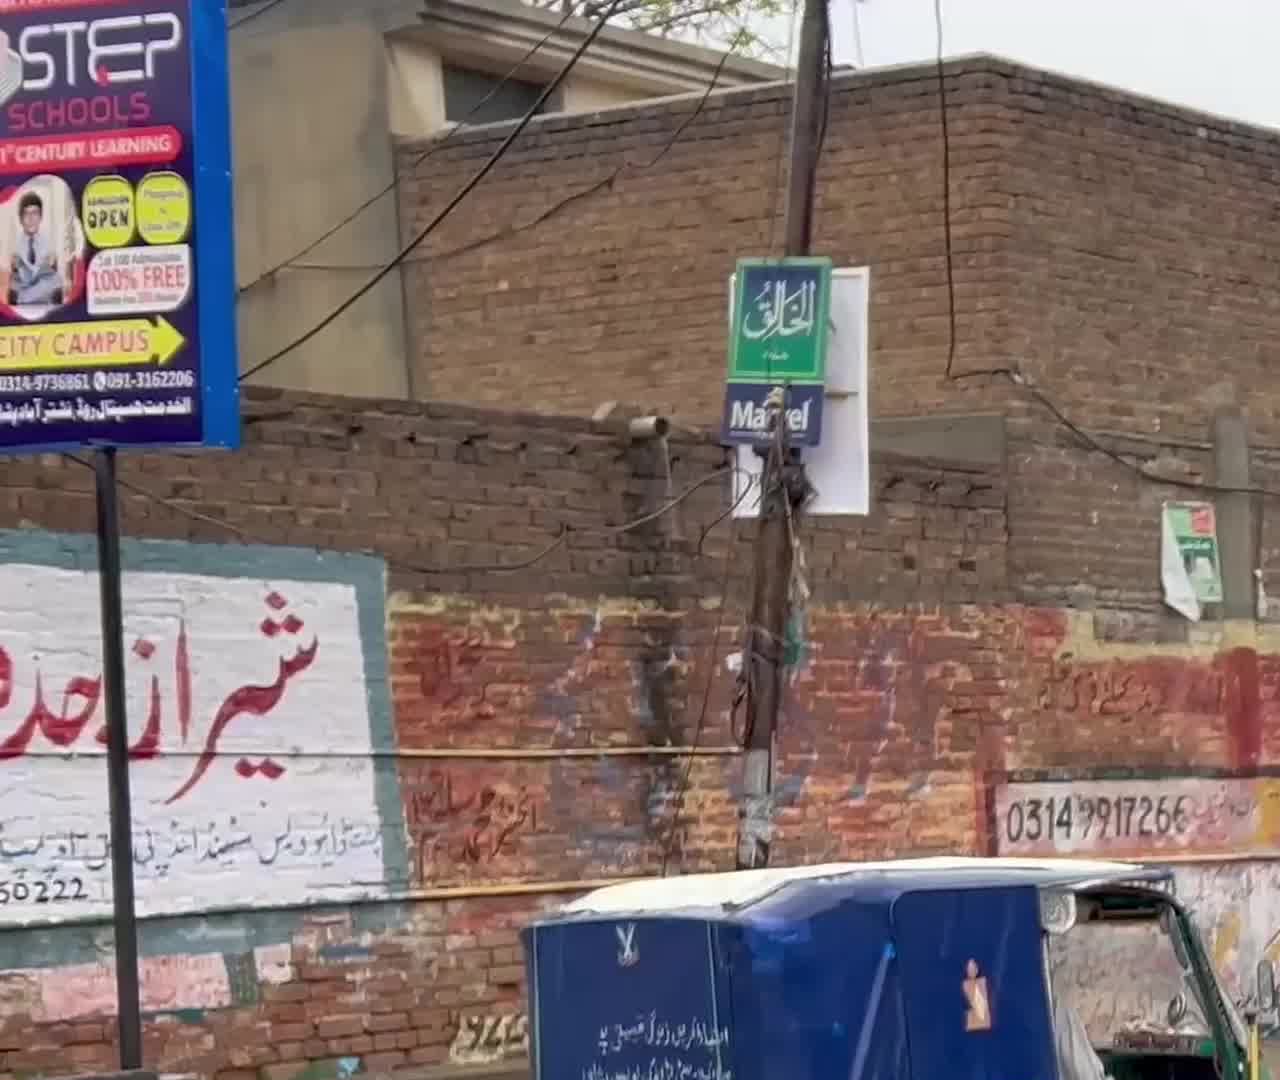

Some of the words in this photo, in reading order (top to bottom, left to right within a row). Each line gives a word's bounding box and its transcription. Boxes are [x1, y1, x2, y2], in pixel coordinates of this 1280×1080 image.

[19, 12, 182, 91] STEP
[7, 91, 152, 131] SCHOOLS
[15, 141, 86, 164] CENTURY
[89, 134, 172, 158] LEARNING
[87, 210, 129, 229] OPEN
[92, 267, 138, 291] 100%
[143, 265, 186, 288] FREE
[52, 329, 150, 356] CAMPUS
